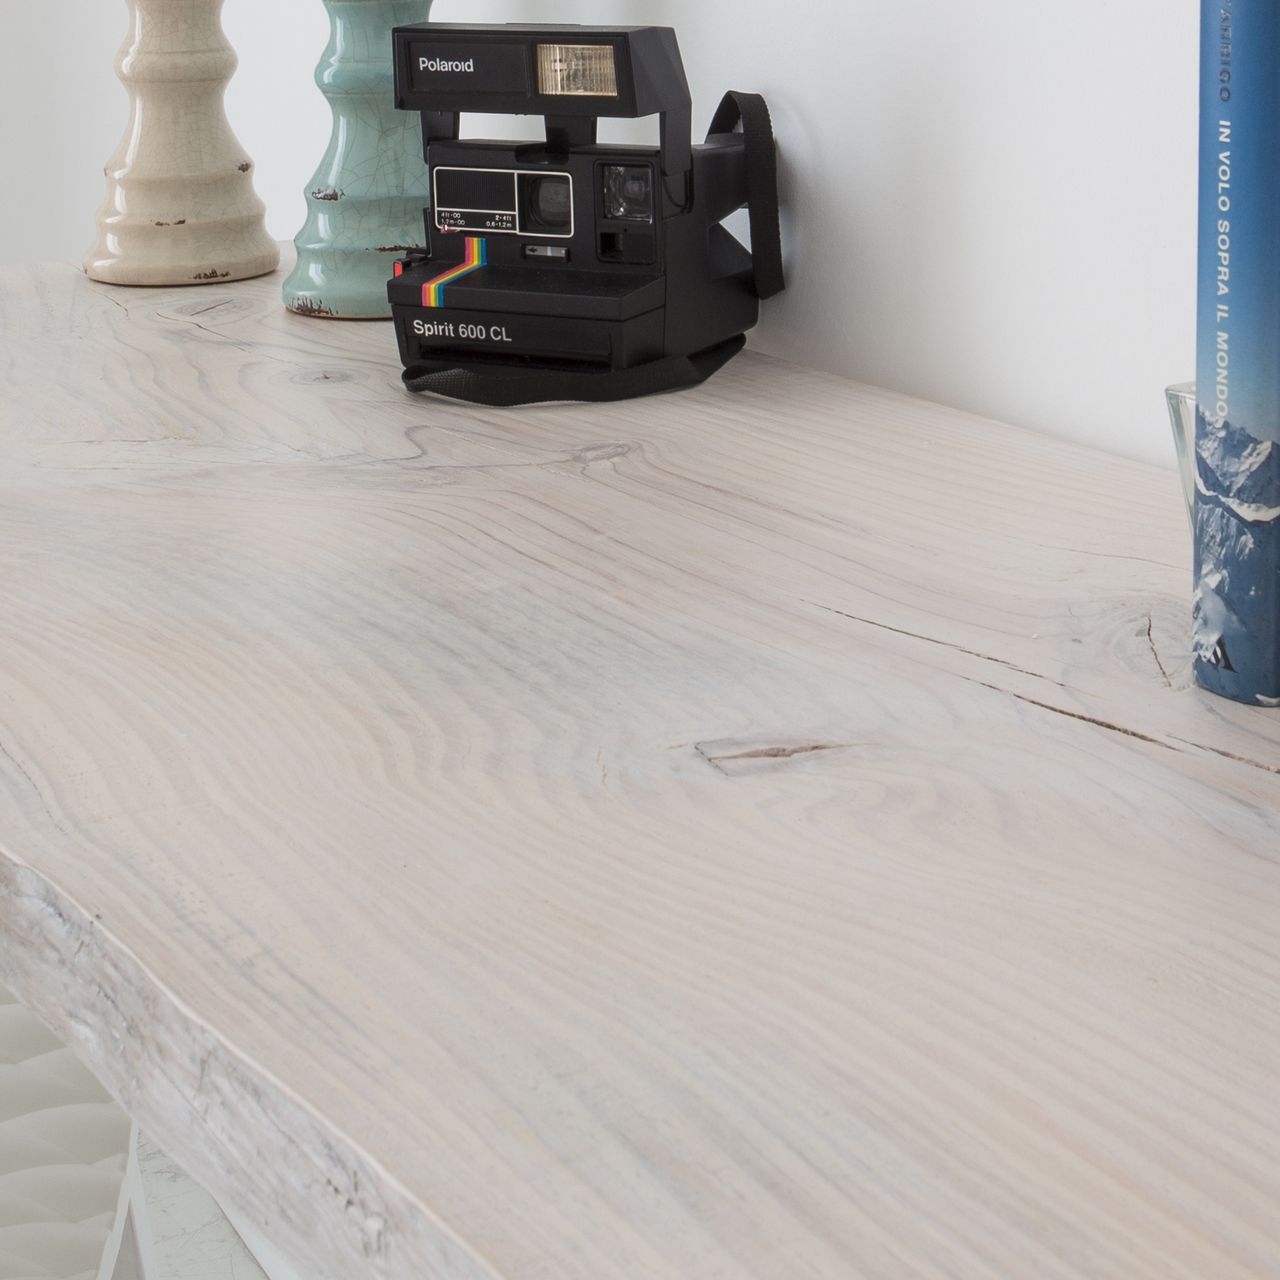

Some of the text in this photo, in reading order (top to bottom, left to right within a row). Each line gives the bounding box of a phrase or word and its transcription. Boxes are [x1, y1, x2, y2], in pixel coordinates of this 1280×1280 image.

[419, 57, 474, 72] Polaroid
[1216, 120, 1231, 420] IN VOLO SOPRA IL MONDO
[413, 319, 512, 341] Spirit 600 CL
